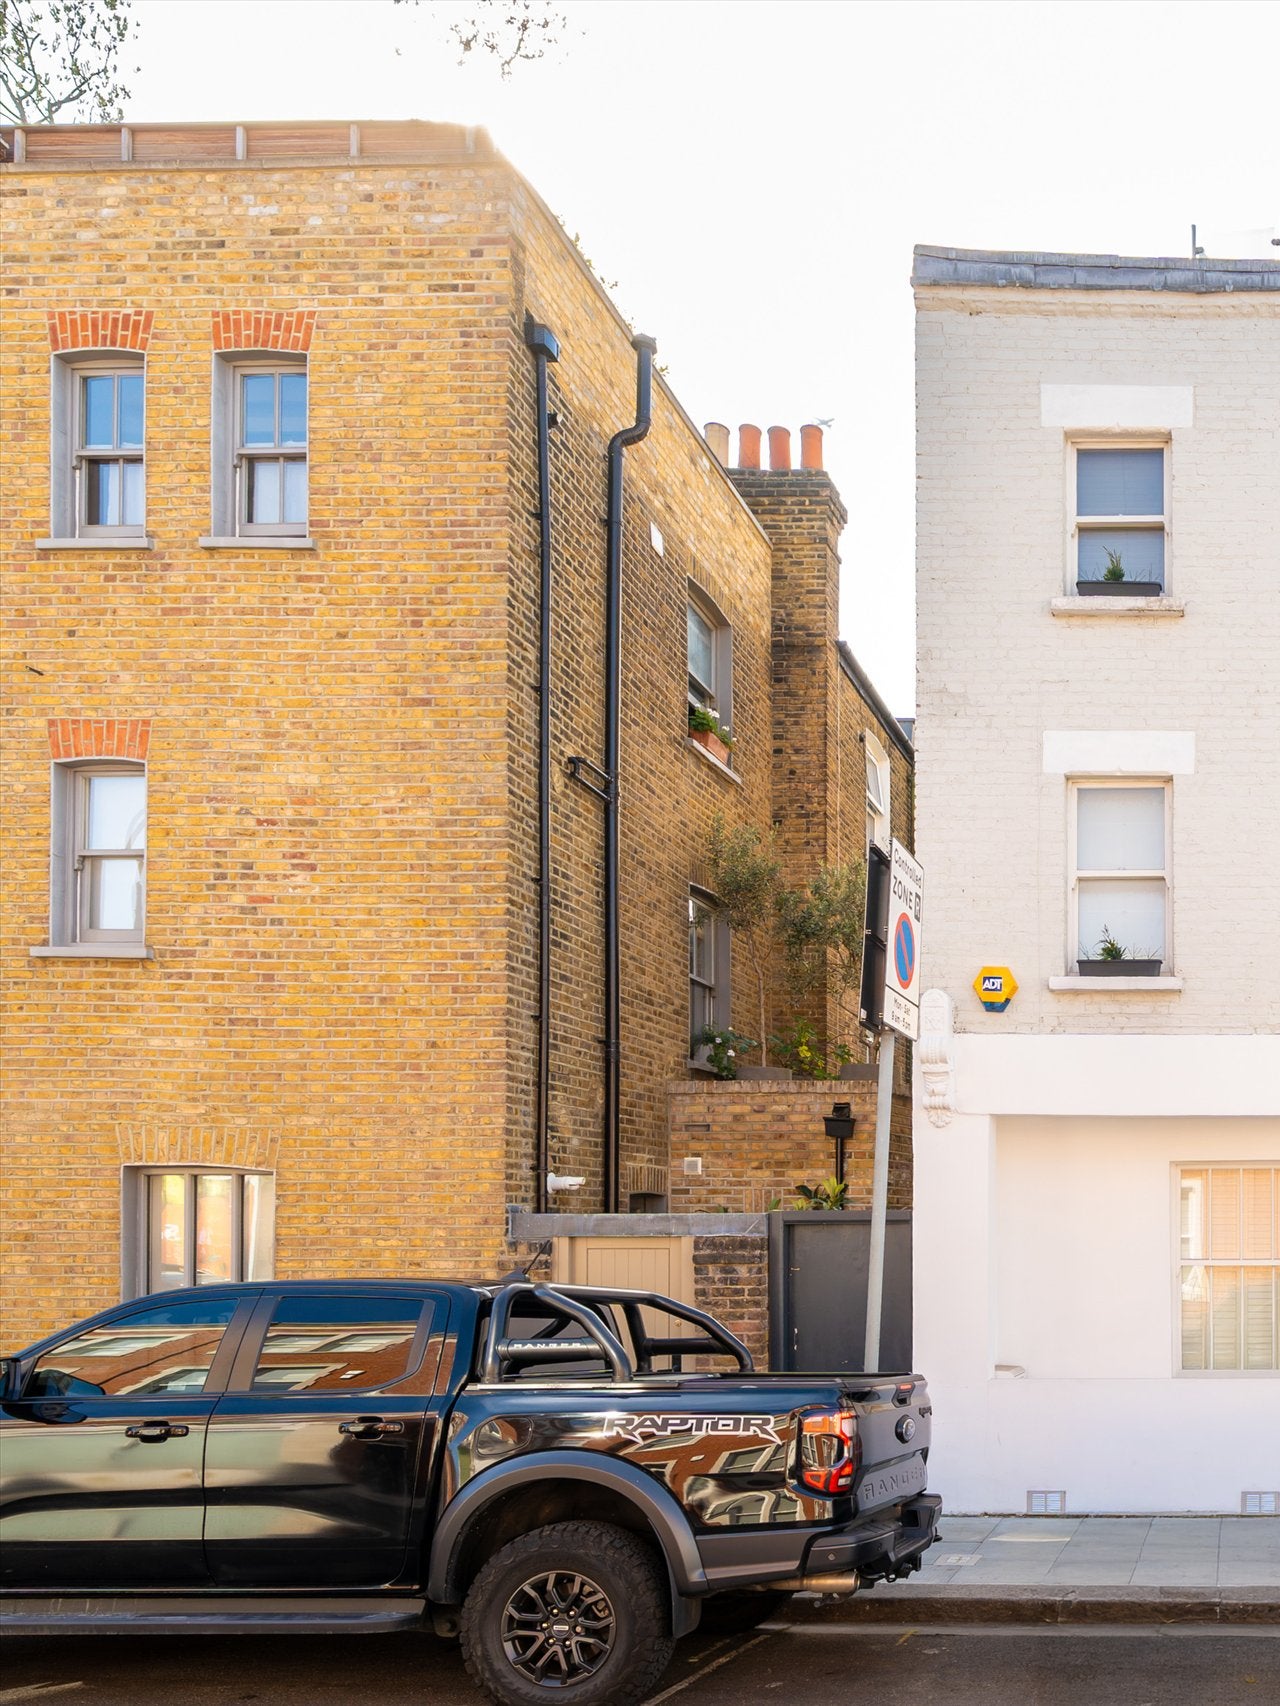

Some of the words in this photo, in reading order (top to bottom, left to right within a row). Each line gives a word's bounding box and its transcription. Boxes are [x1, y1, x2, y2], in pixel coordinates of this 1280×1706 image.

[894, 848, 922, 889] Controlled
[893, 875, 913, 910] ZONE
[982, 978, 1002, 990] ADT
[603, 1415, 782, 1446] RAPTOR
